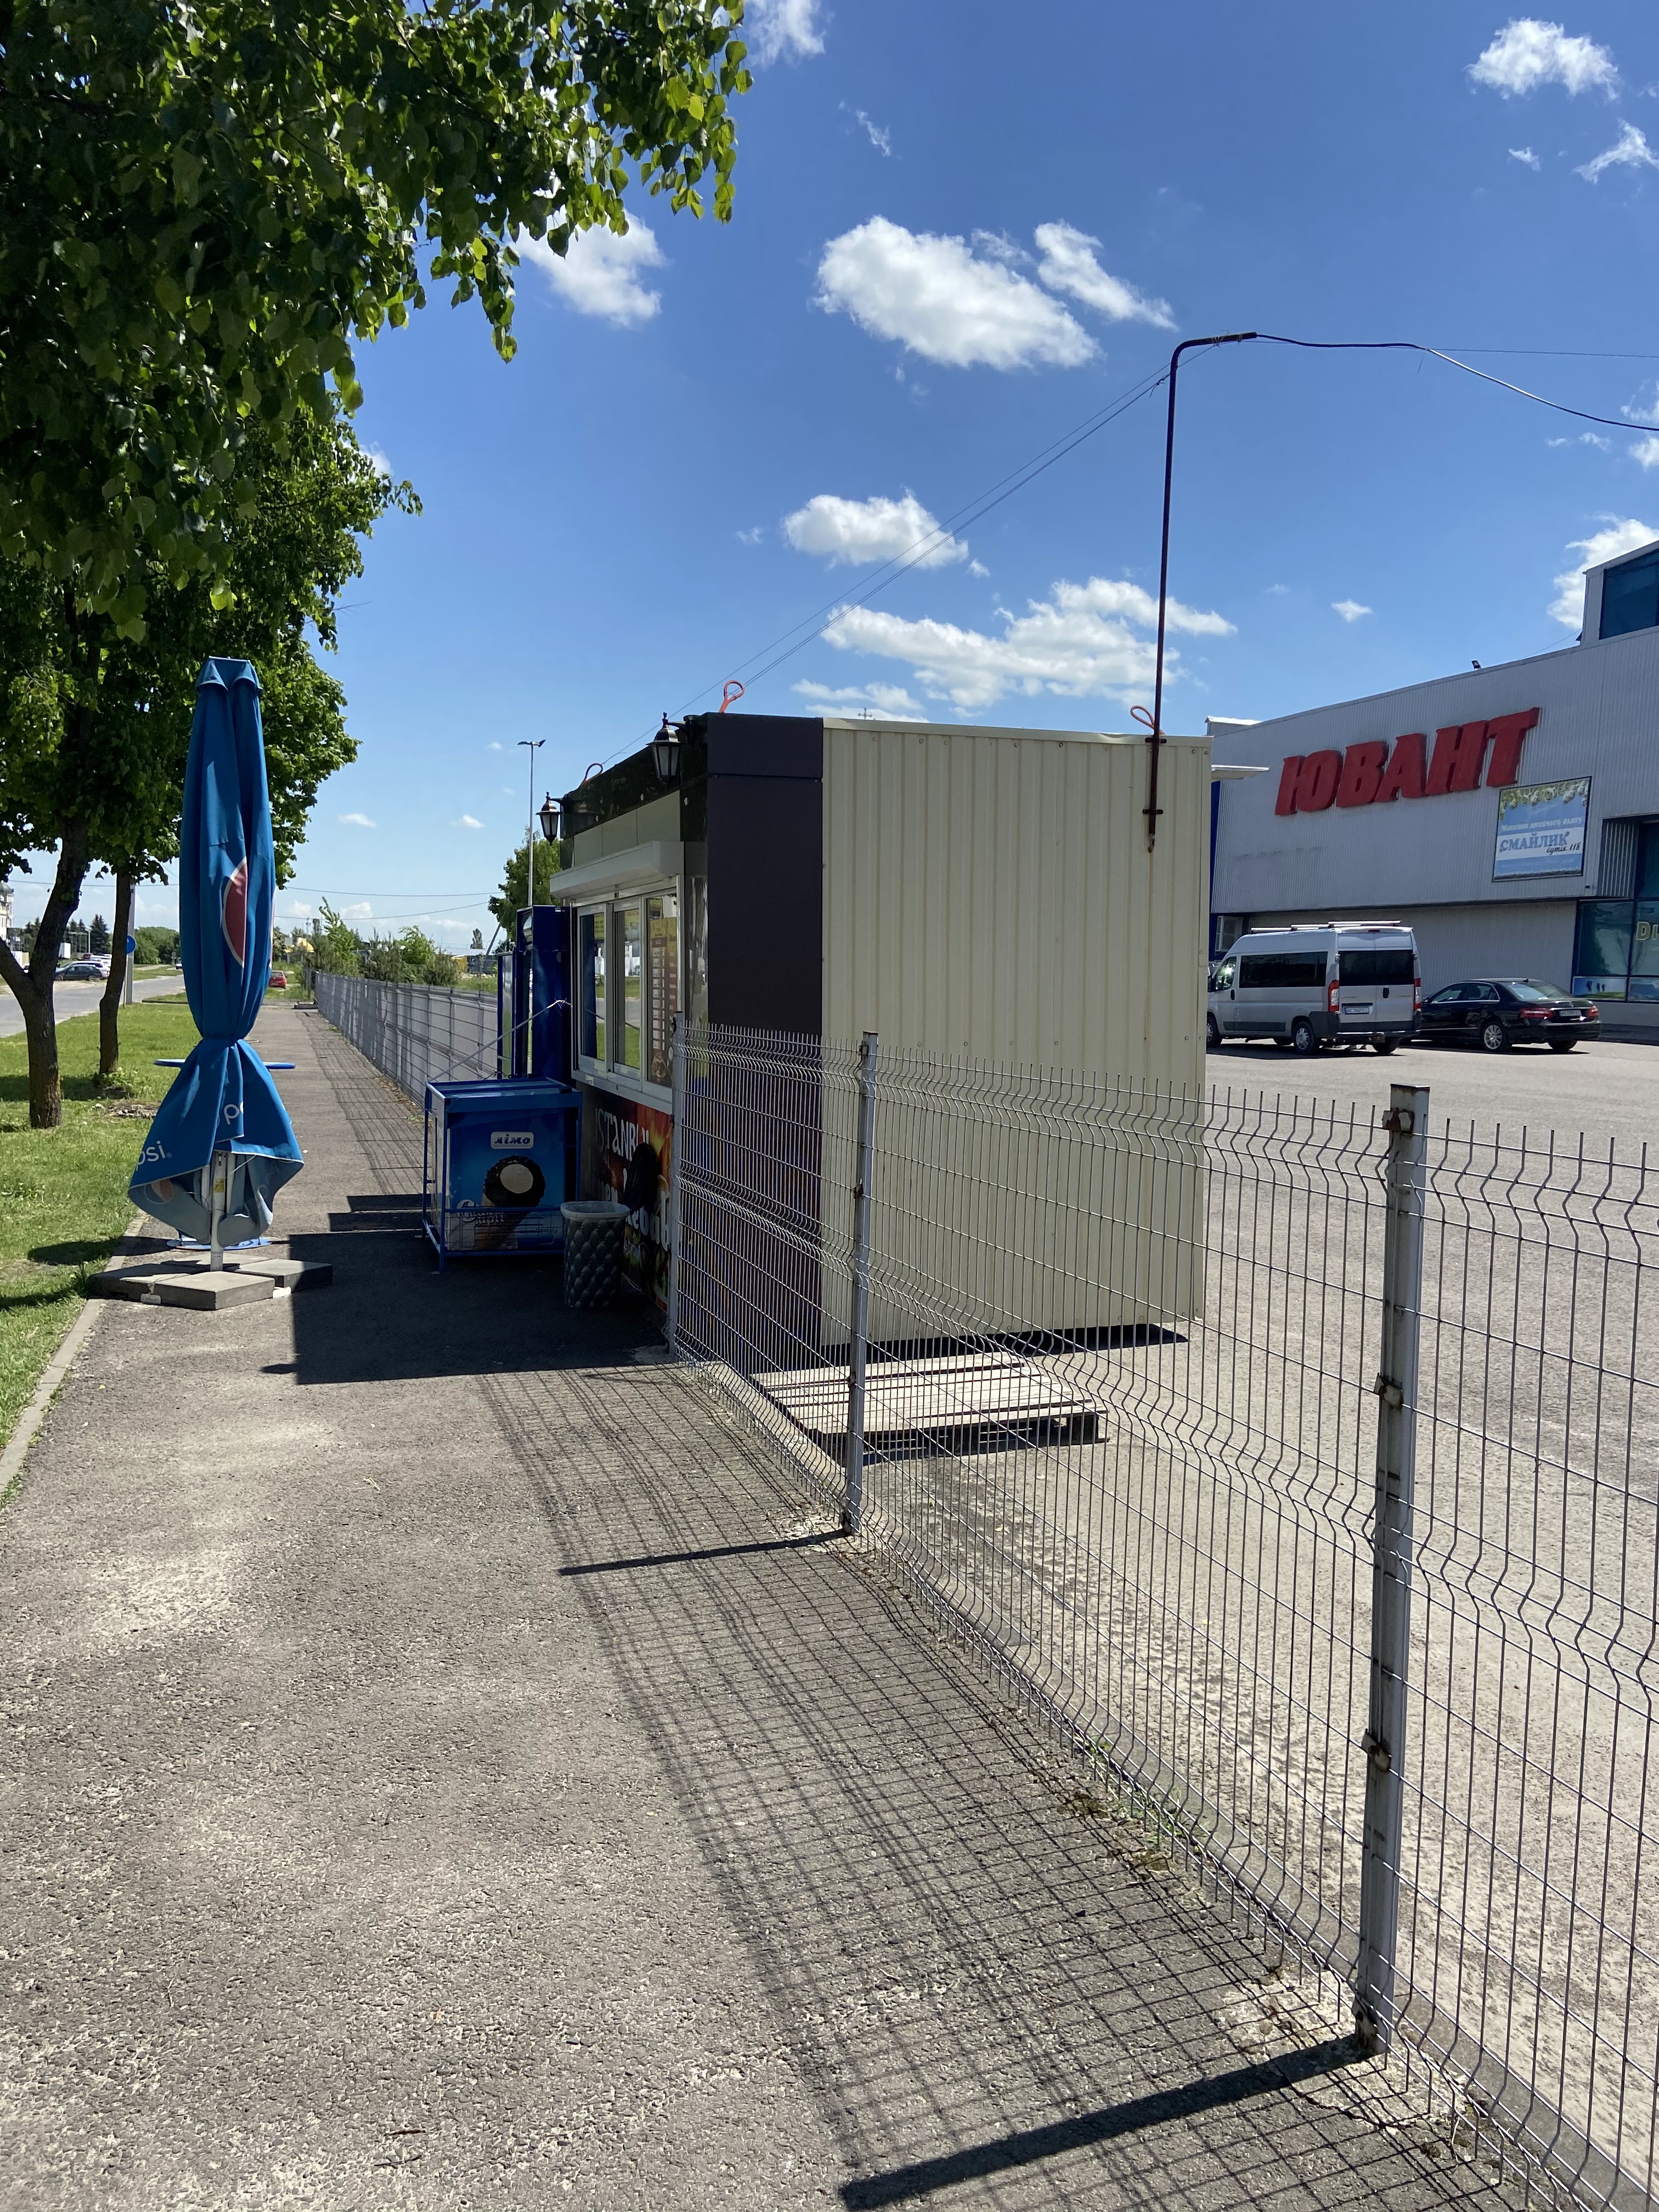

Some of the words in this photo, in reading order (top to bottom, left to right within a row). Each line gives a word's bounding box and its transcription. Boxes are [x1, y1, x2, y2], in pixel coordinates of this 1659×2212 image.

[1274, 707, 1541, 815] ЮВАНТ
[1501, 823, 1528, 832] Магазин
[1500, 831, 1570, 853] СМАЙЛИК
[1569, 843, 1582, 851] 118
